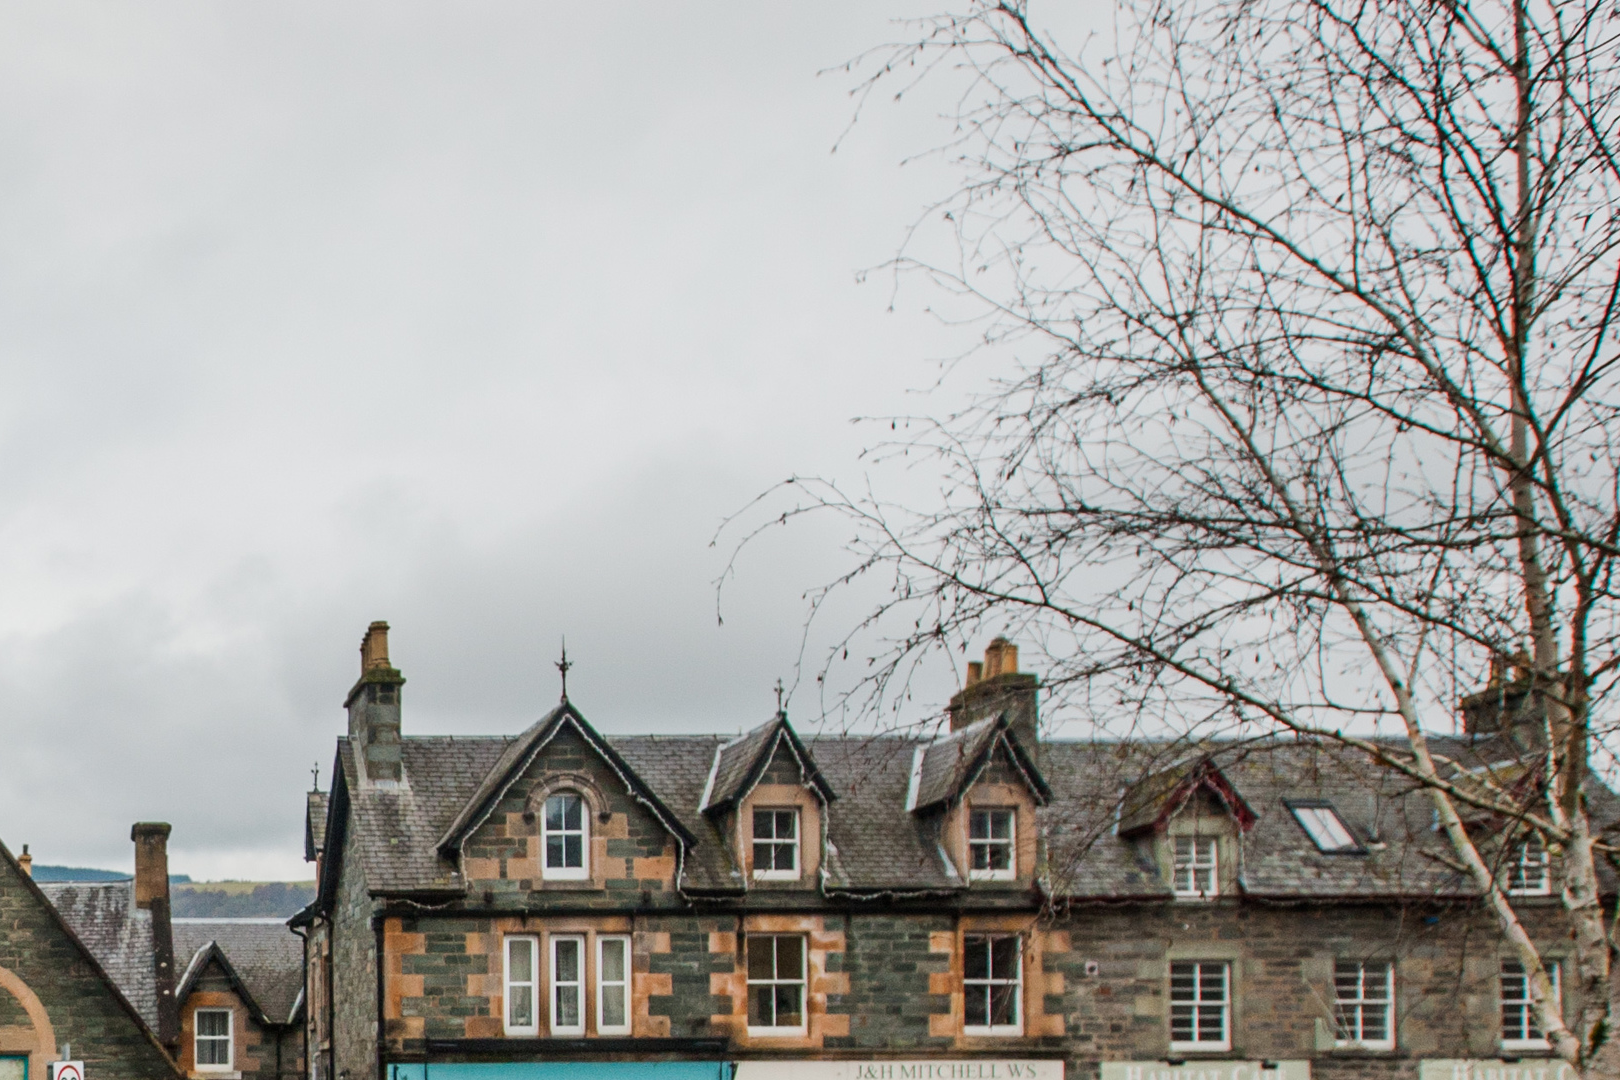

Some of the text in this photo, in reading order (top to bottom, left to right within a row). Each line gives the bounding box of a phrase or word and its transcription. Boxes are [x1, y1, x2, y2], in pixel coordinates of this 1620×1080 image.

[856, 1062, 1038, 1080] J&H MITCHELL WS
